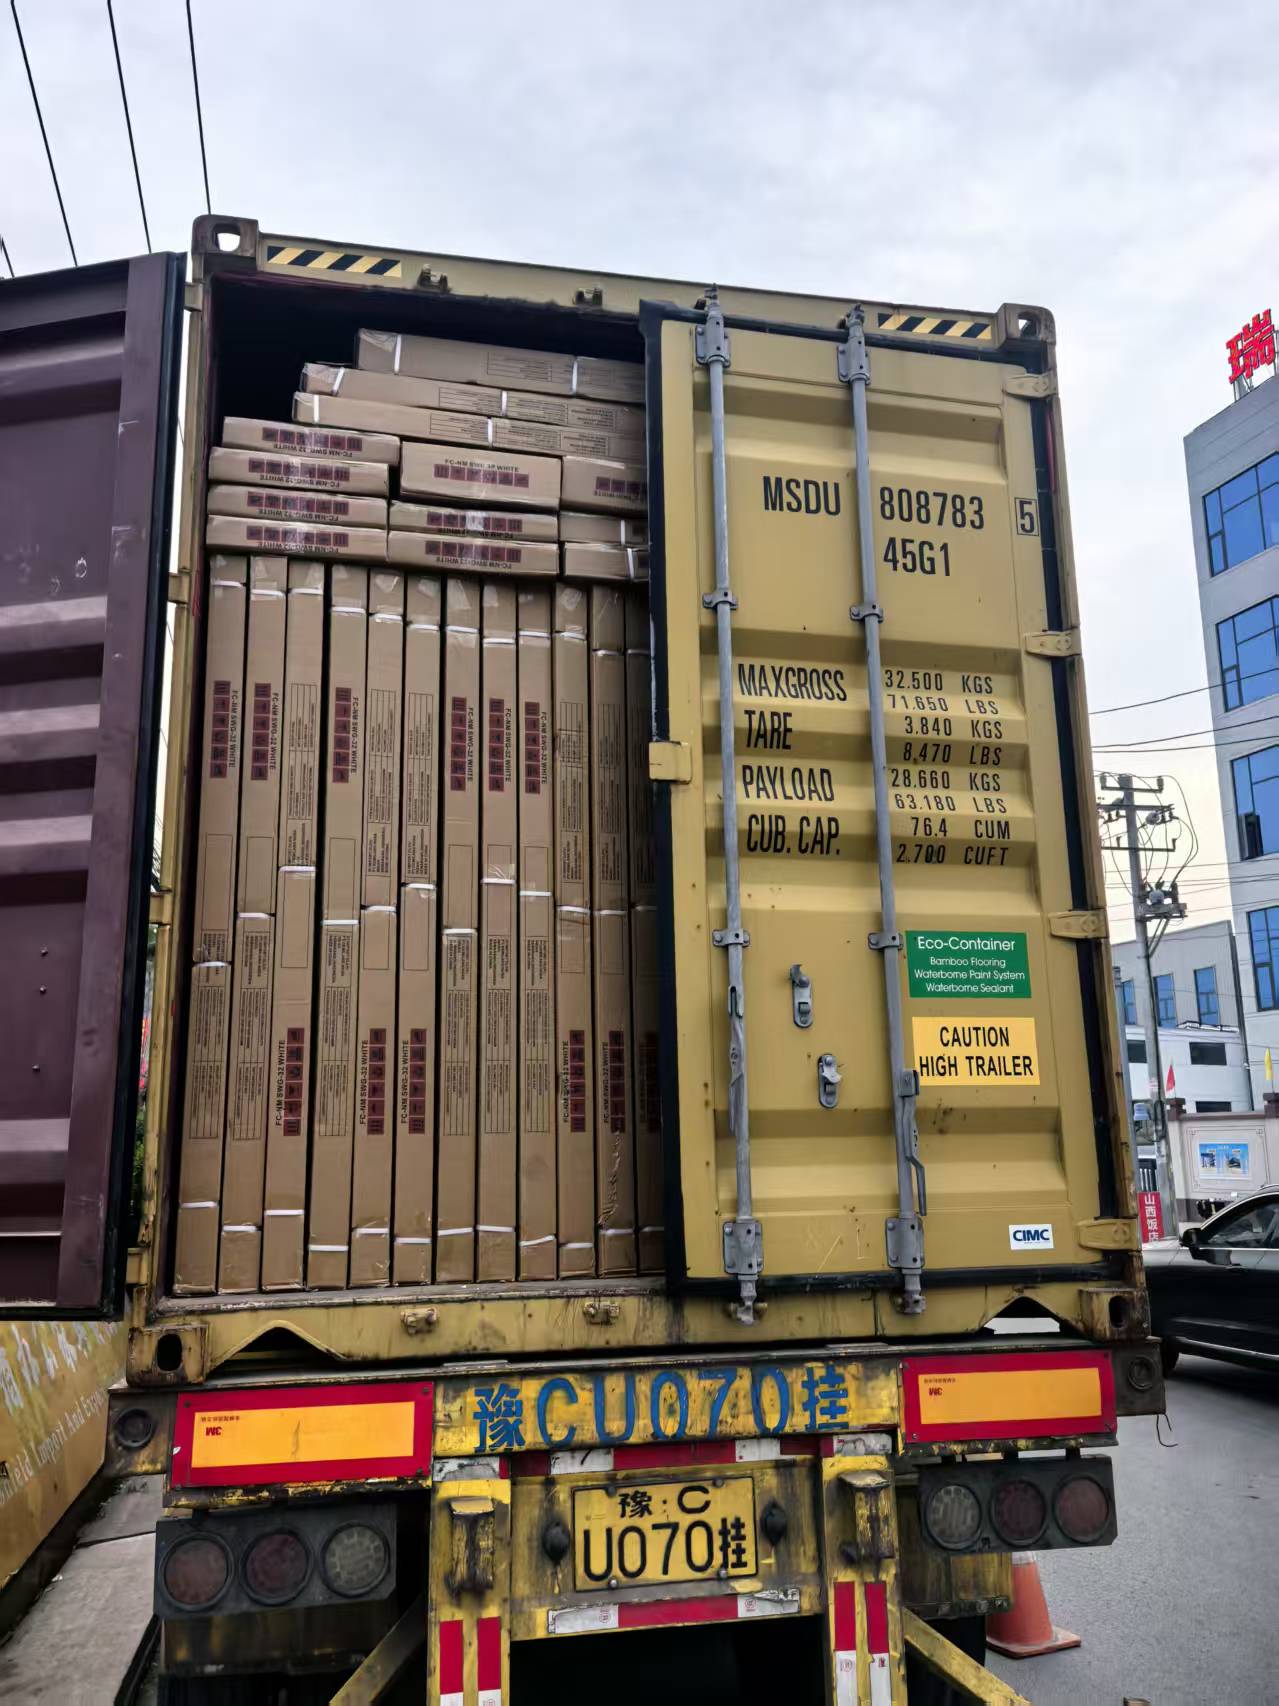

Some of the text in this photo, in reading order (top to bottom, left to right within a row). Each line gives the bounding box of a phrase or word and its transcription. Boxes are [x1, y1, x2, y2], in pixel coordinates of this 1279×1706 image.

[1226, 309, 1276, 384] 瑞
[763, 476, 1035, 533] MSDU 808783 5
[884, 537, 950, 576] 45G1
[738, 664, 992, 701] MAXGROSS 32.500 KGS
[888, 695, 998, 714] 71.650 LBS
[744, 710, 1002, 749] TARE 3.840 KGS
[904, 743, 1001, 765] 8.470 LBS
[742, 765, 1000, 801] PAYLOAD 28.660 KGS
[895, 794, 1007, 813] 63.180 LBS
[747, 815, 1010, 855] CUB. CAP. 76.4 CUM
[964, 846, 1008, 865] CUFT
[918, 937, 1015, 950] Eco-Container
[931, 957, 1006, 968] Bamboo Flooring
[914, 970, 1025, 980] Waterborne Paint System
[926, 983, 1014, 993] Waterborne Sealant
[940, 1027, 1010, 1047] CAUTION
[920, 1056, 1033, 1076] HIGH TRAILER
[1013, 1229, 1050, 1241] CIMC
[929, 1387, 942, 1396] 3M
[473, 1364, 849, 1452] 豫CU070挂
[64, 1401, 86, 1437] And
[206, 1426, 222, 1436] 3M
[583, 1516, 748, 1581] U070挂
